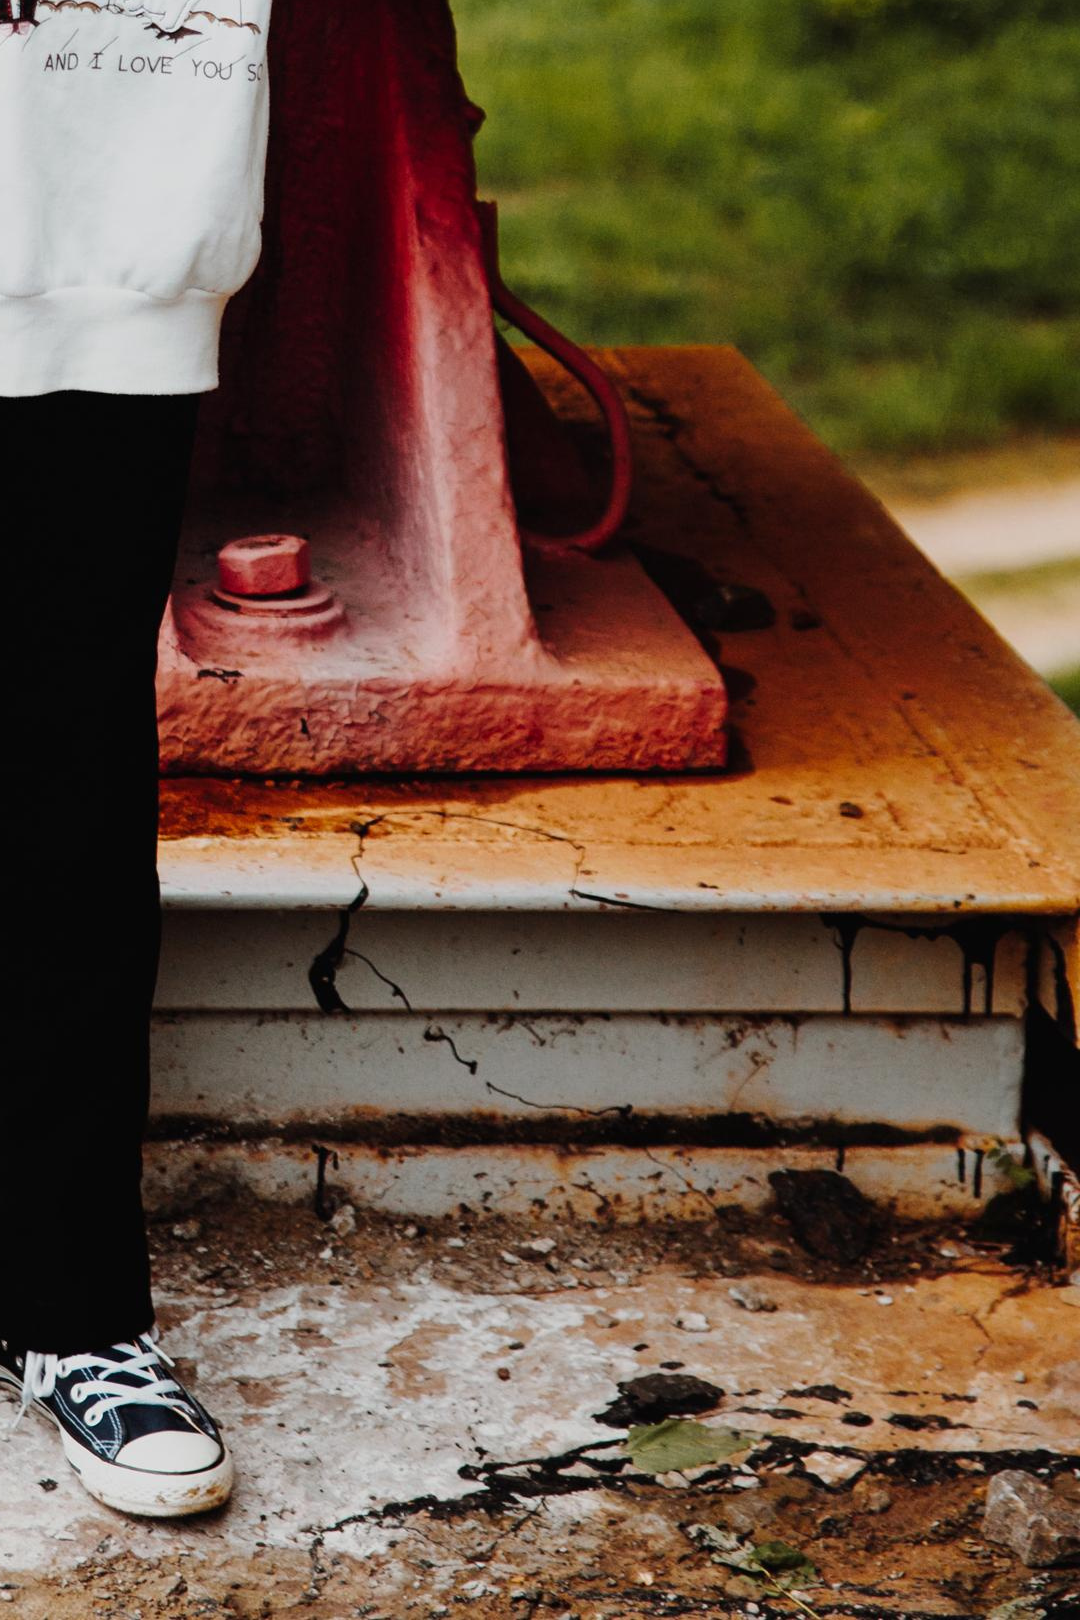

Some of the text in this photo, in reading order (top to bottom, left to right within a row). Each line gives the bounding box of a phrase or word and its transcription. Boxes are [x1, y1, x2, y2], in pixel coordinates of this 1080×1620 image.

[44, 53, 79, 72] AND
[91, 53, 103, 70] I
[118, 55, 173, 74] LOVE
[192, 59, 232, 81] YOU
